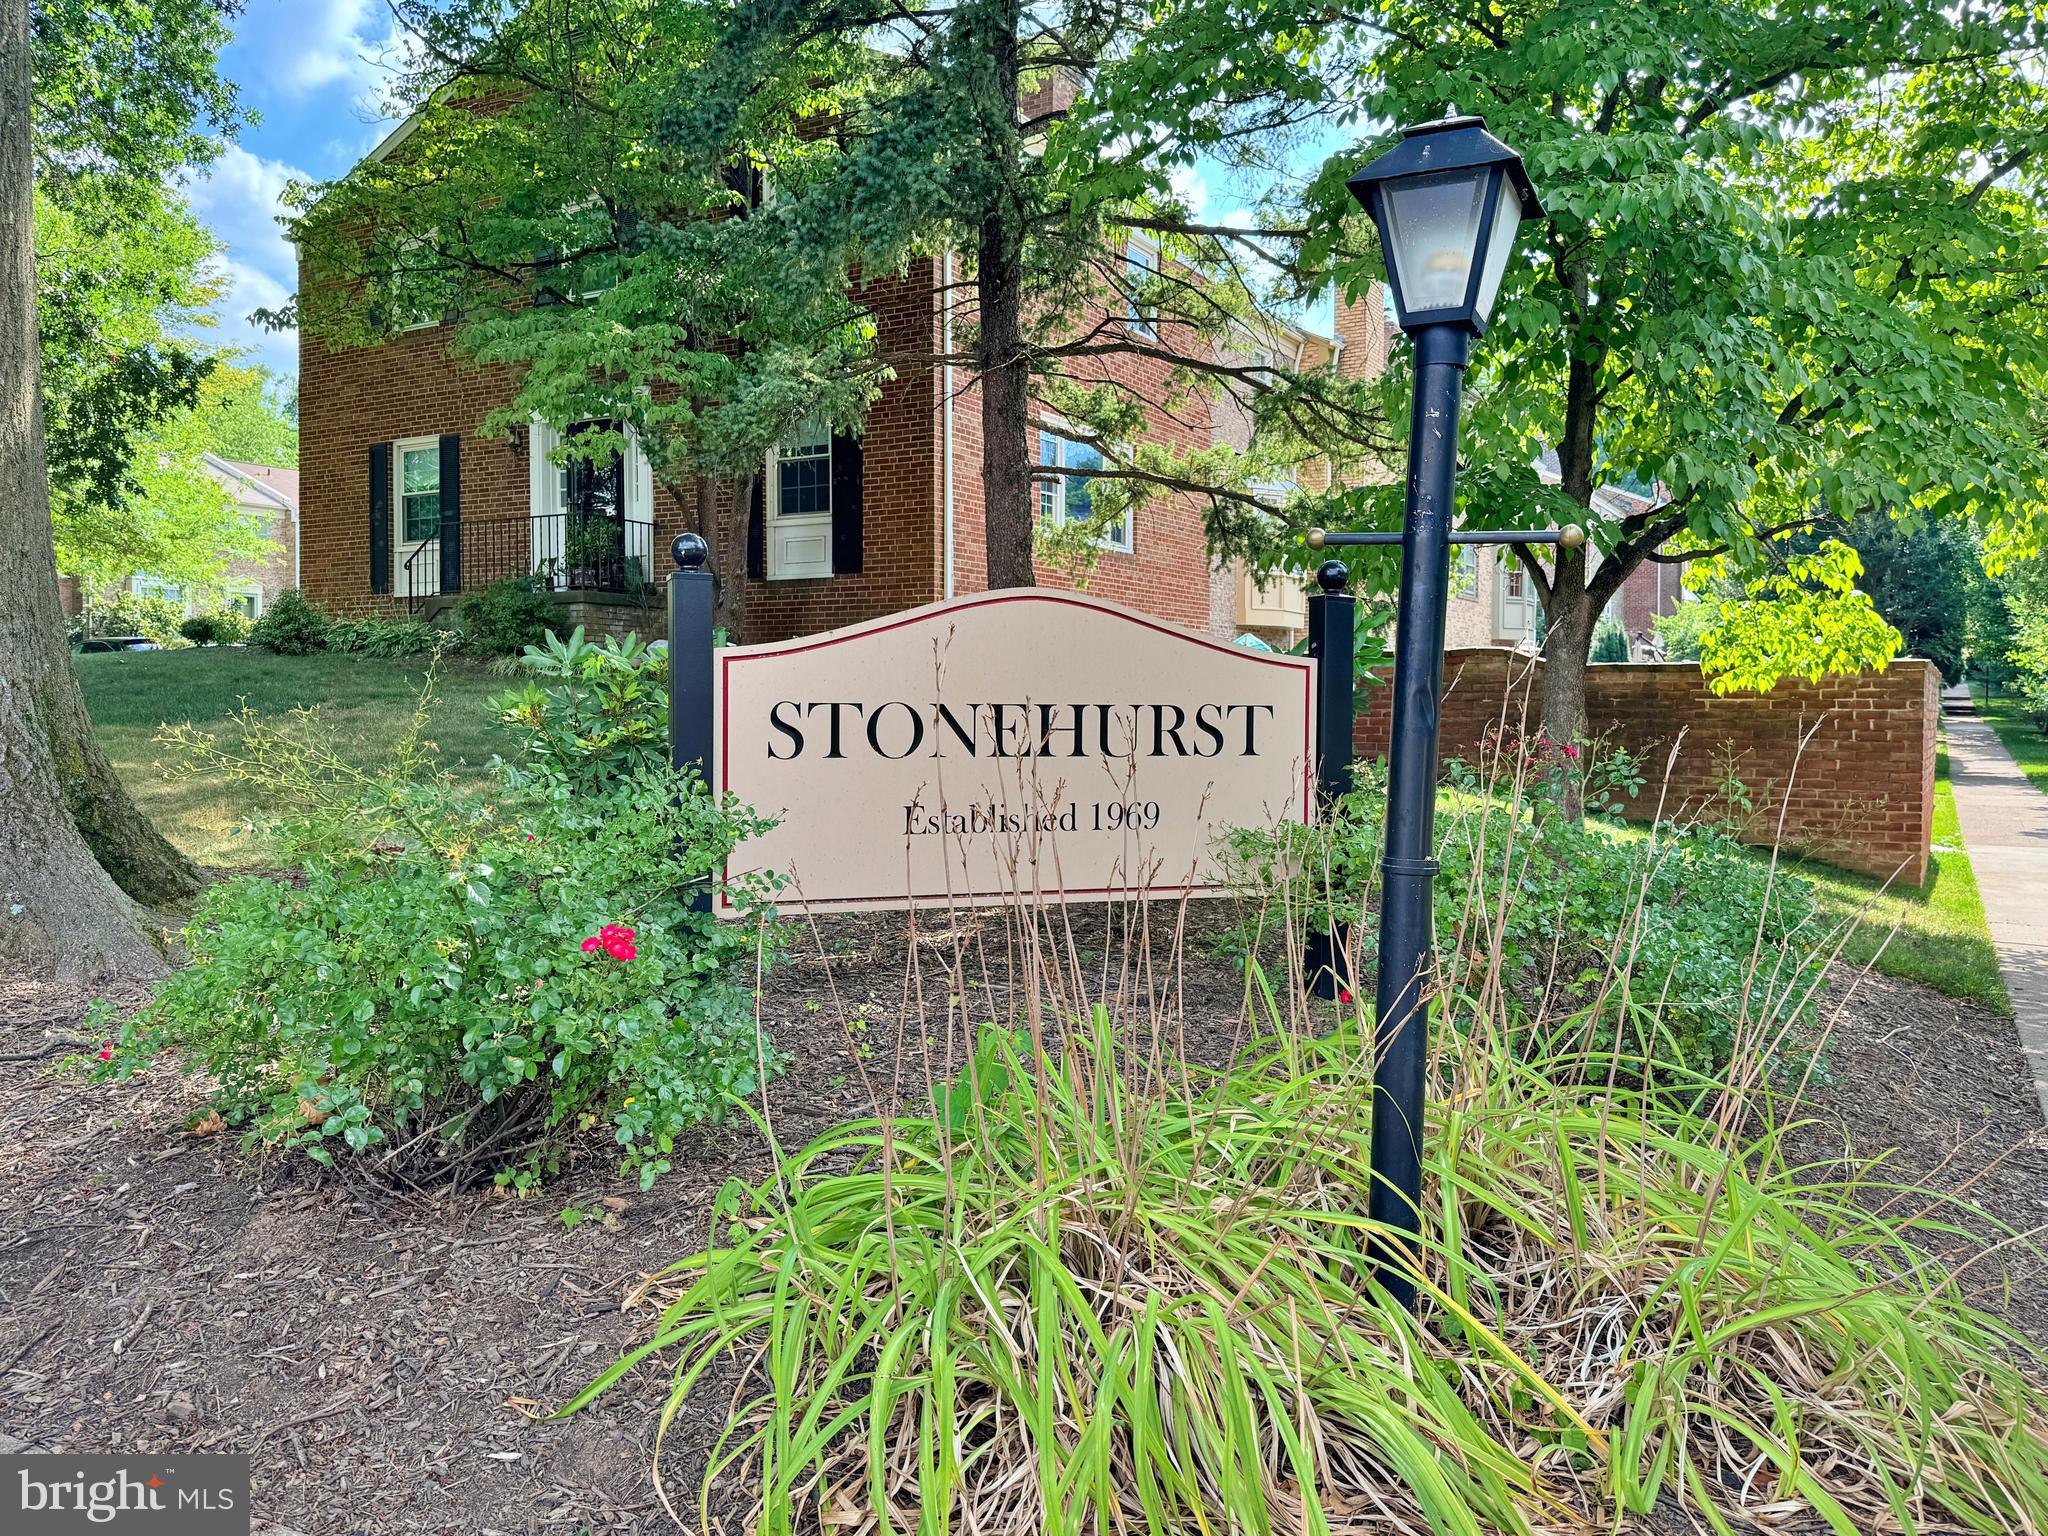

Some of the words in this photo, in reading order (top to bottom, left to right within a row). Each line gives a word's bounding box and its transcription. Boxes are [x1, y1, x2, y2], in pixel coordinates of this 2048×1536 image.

[767, 701, 1274, 760] STONEHURST
[903, 803, 1077, 836] Established
[1090, 801, 1161, 832] 1969
